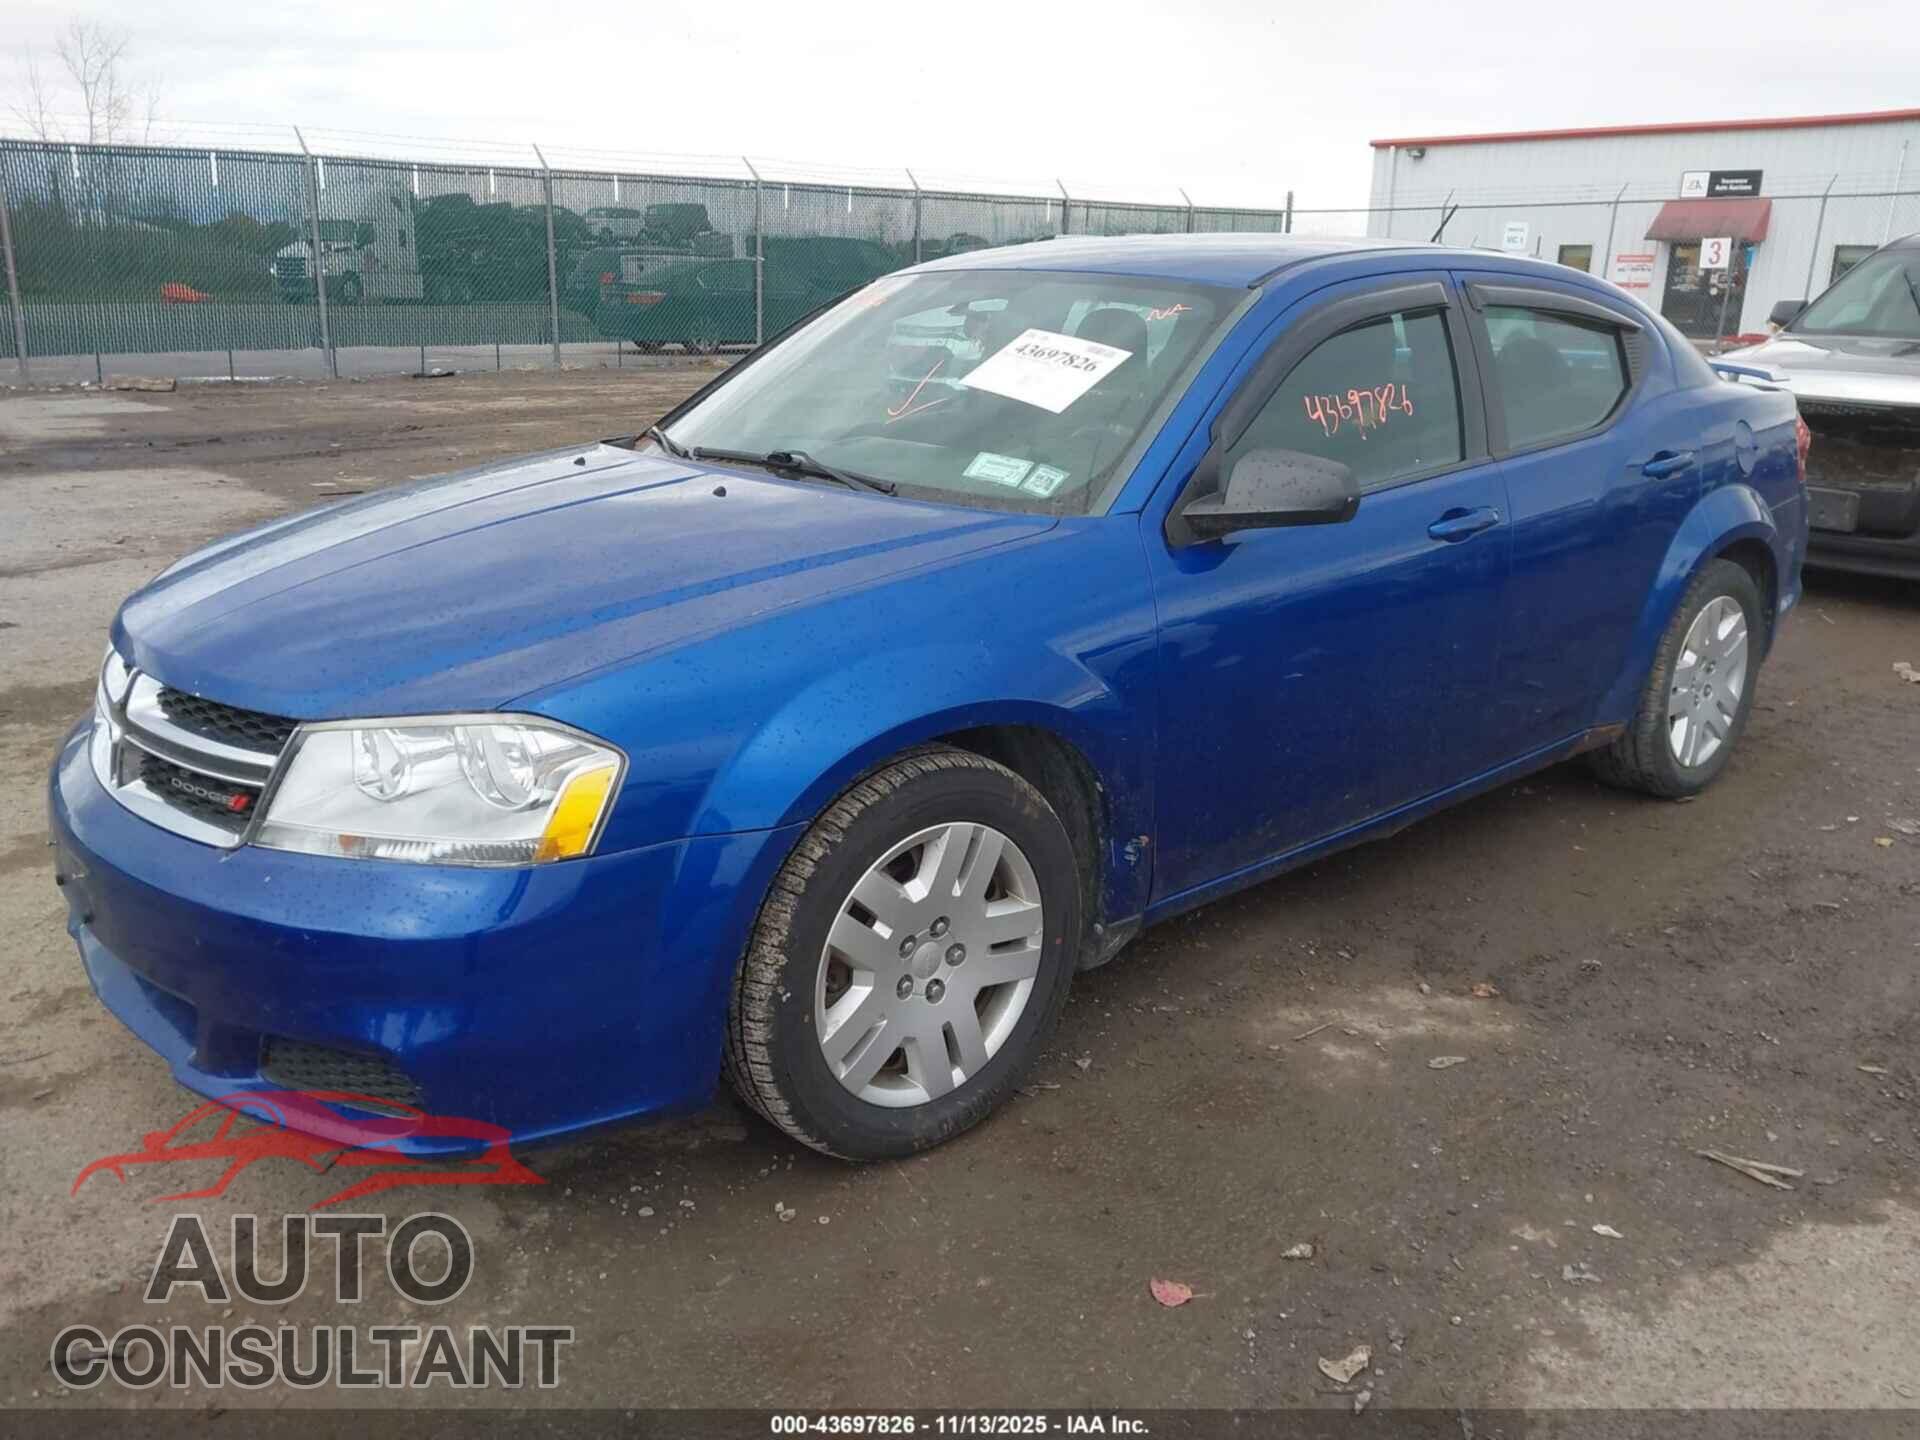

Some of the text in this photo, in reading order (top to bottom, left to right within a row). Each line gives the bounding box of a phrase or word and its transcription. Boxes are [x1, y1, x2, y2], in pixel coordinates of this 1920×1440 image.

[1708, 241, 1722, 265] 3
[1015, 343, 1097, 373] 43697826
[1304, 383, 1413, 440] 43697826
